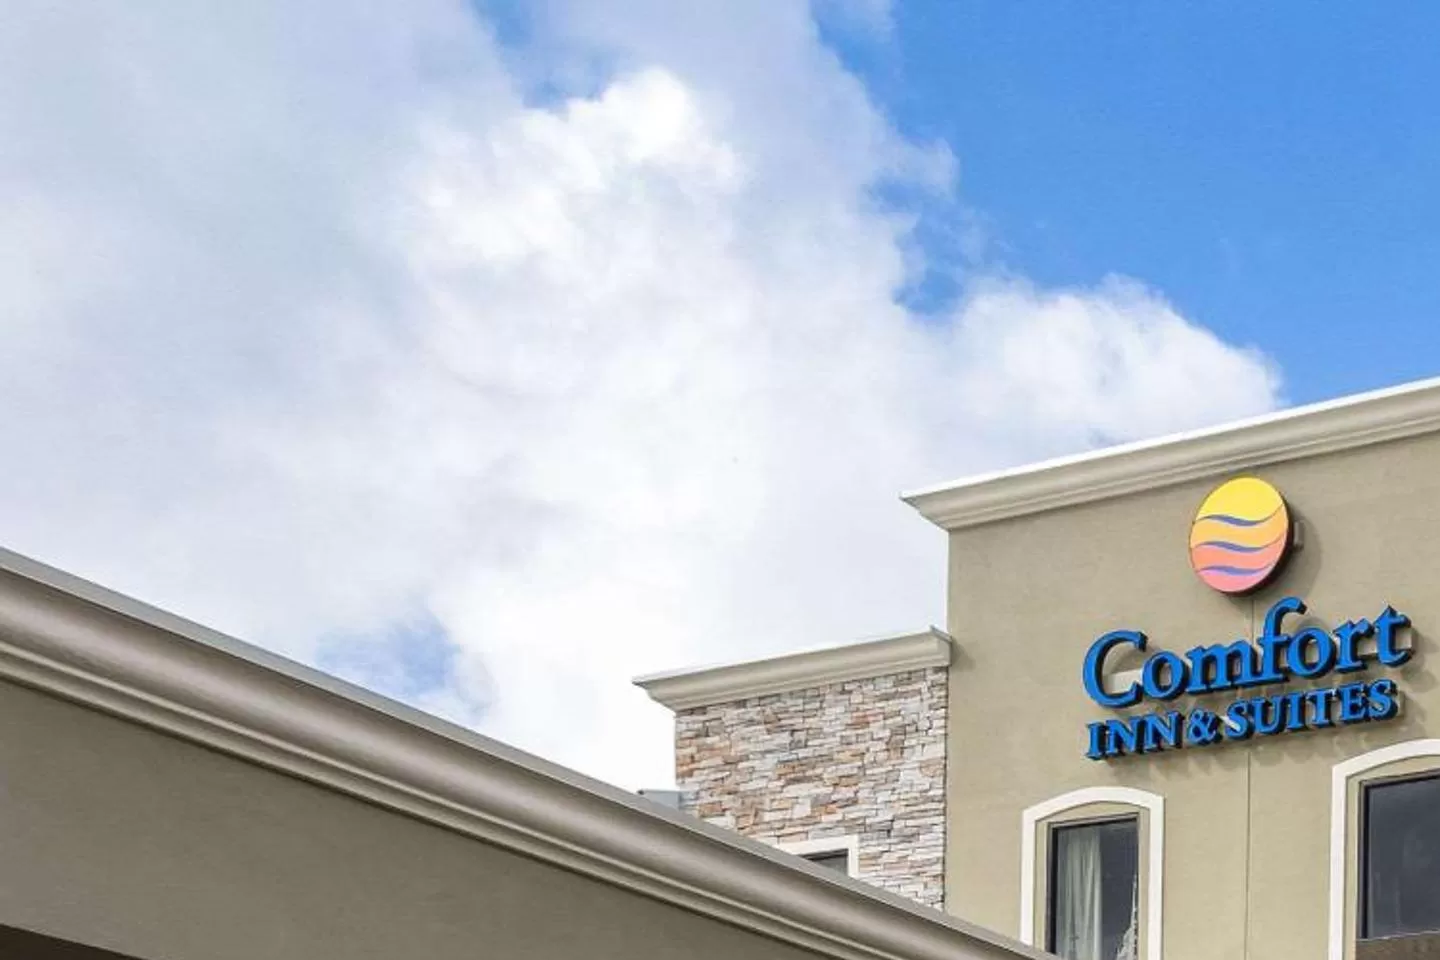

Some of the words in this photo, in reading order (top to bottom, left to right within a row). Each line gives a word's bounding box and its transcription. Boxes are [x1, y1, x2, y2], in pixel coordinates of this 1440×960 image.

[1082, 597, 1412, 709] Comfort
[1086, 711, 1182, 759] INN
[1226, 679, 1398, 739] SUITES
